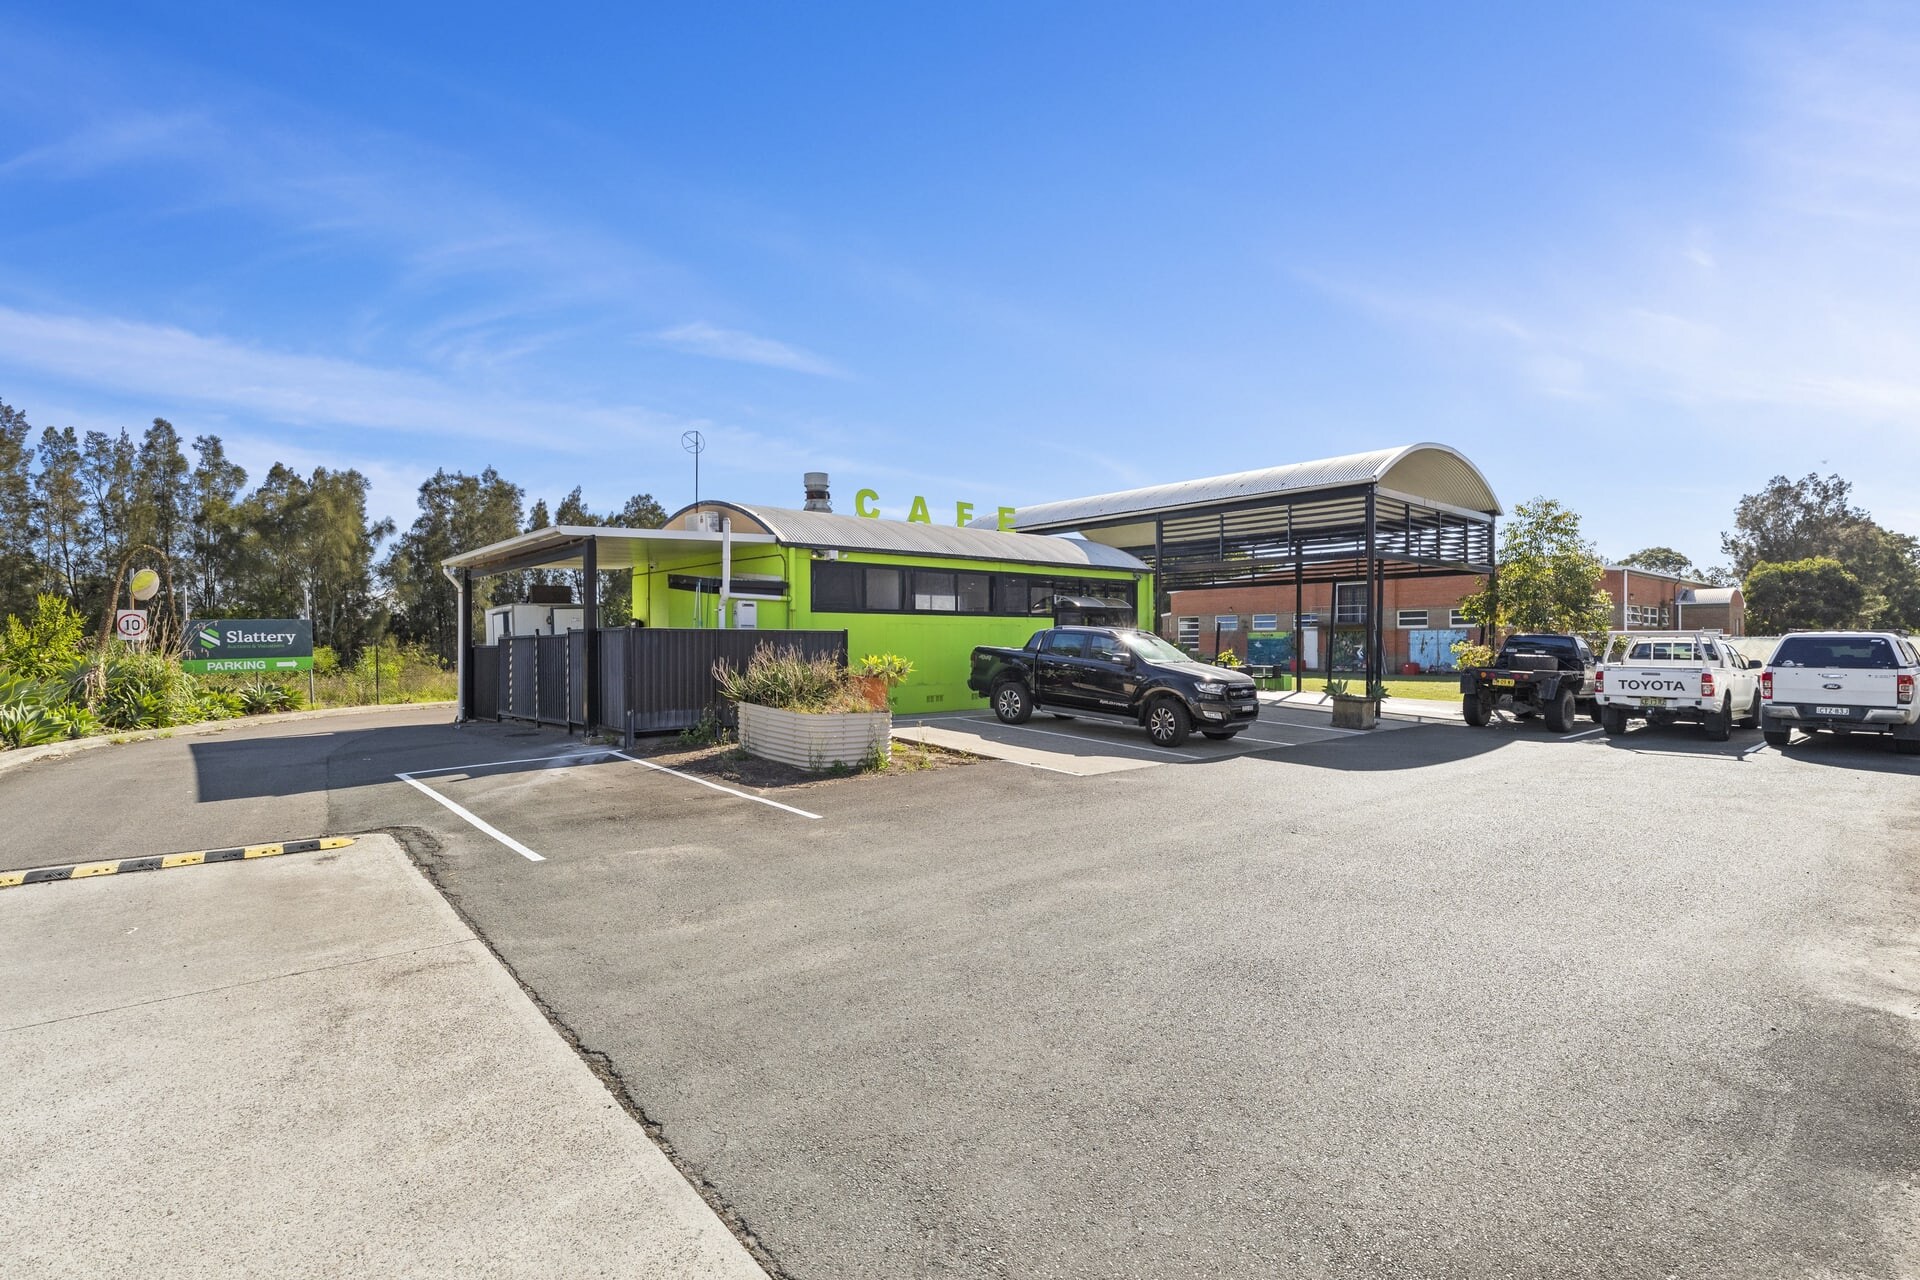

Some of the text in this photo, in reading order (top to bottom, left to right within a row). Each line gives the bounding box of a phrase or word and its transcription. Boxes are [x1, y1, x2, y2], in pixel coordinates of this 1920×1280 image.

[855, 488, 1016, 533] CAFE
[125, 619, 141, 631] 10
[226, 630, 297, 645] Slattery
[206, 660, 267, 671] PARKING
[1618, 680, 1686, 692] TOYOTA
